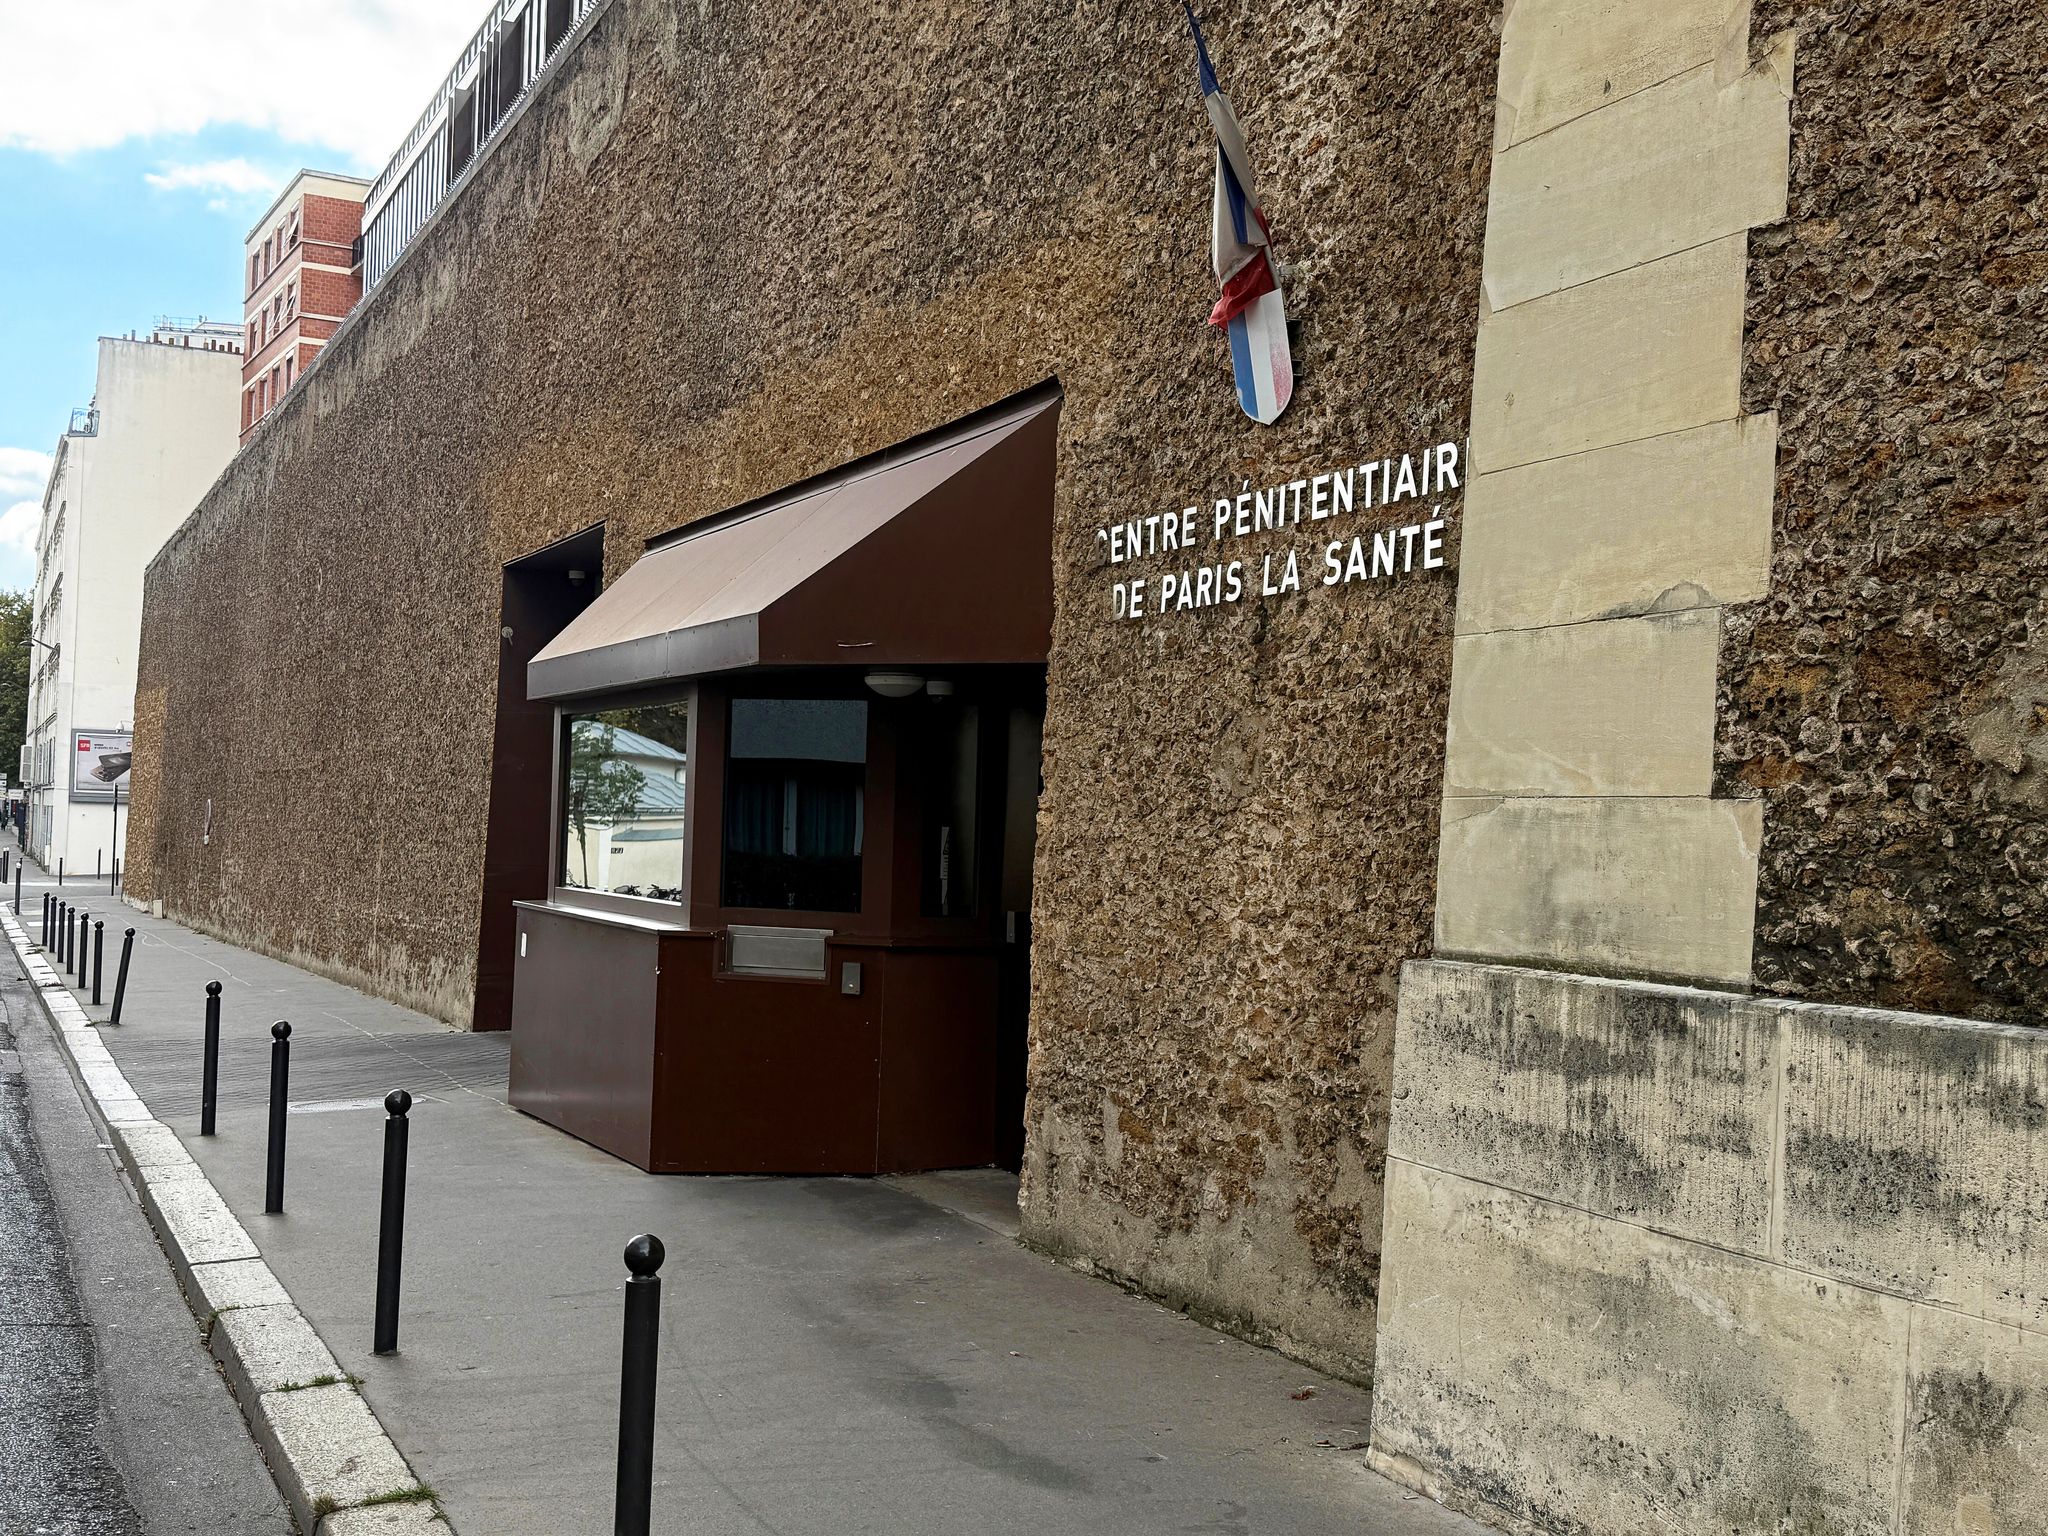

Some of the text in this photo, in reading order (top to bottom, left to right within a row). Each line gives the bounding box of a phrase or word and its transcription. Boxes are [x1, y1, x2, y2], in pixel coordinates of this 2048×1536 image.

[1215, 438, 1470, 540] PÉNITENTIAIR
[1113, 505, 1444, 621] DE PARIS LA SANTÉ
